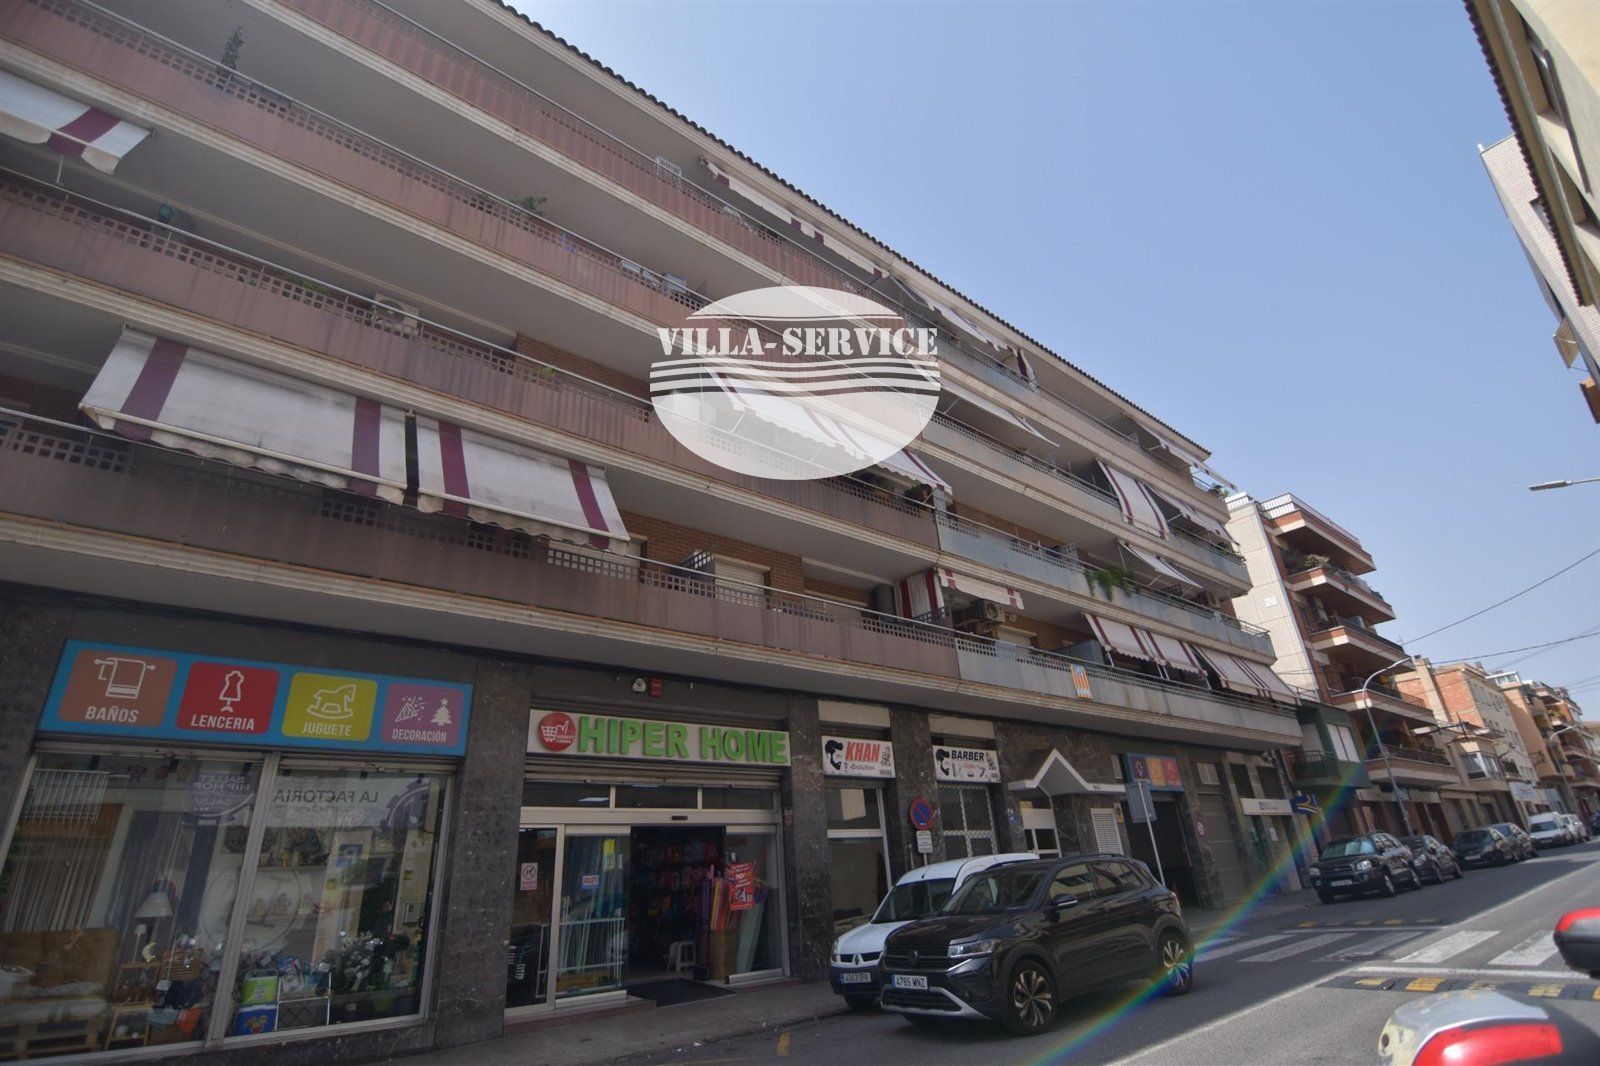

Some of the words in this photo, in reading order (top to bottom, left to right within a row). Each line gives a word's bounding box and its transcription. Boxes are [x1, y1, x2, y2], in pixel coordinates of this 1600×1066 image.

[85, 705, 139, 723] BAÑOS
[191, 714, 255, 730] LENCERIA
[302, 722, 352, 736] JUGUETE
[392, 728, 447, 742] DECORACIÓN
[578, 715, 689, 758] HIPER
[700, 725, 788, 764] HOME
[845, 741, 881, 762] KHAN
[951, 750, 984, 761] BARBER
